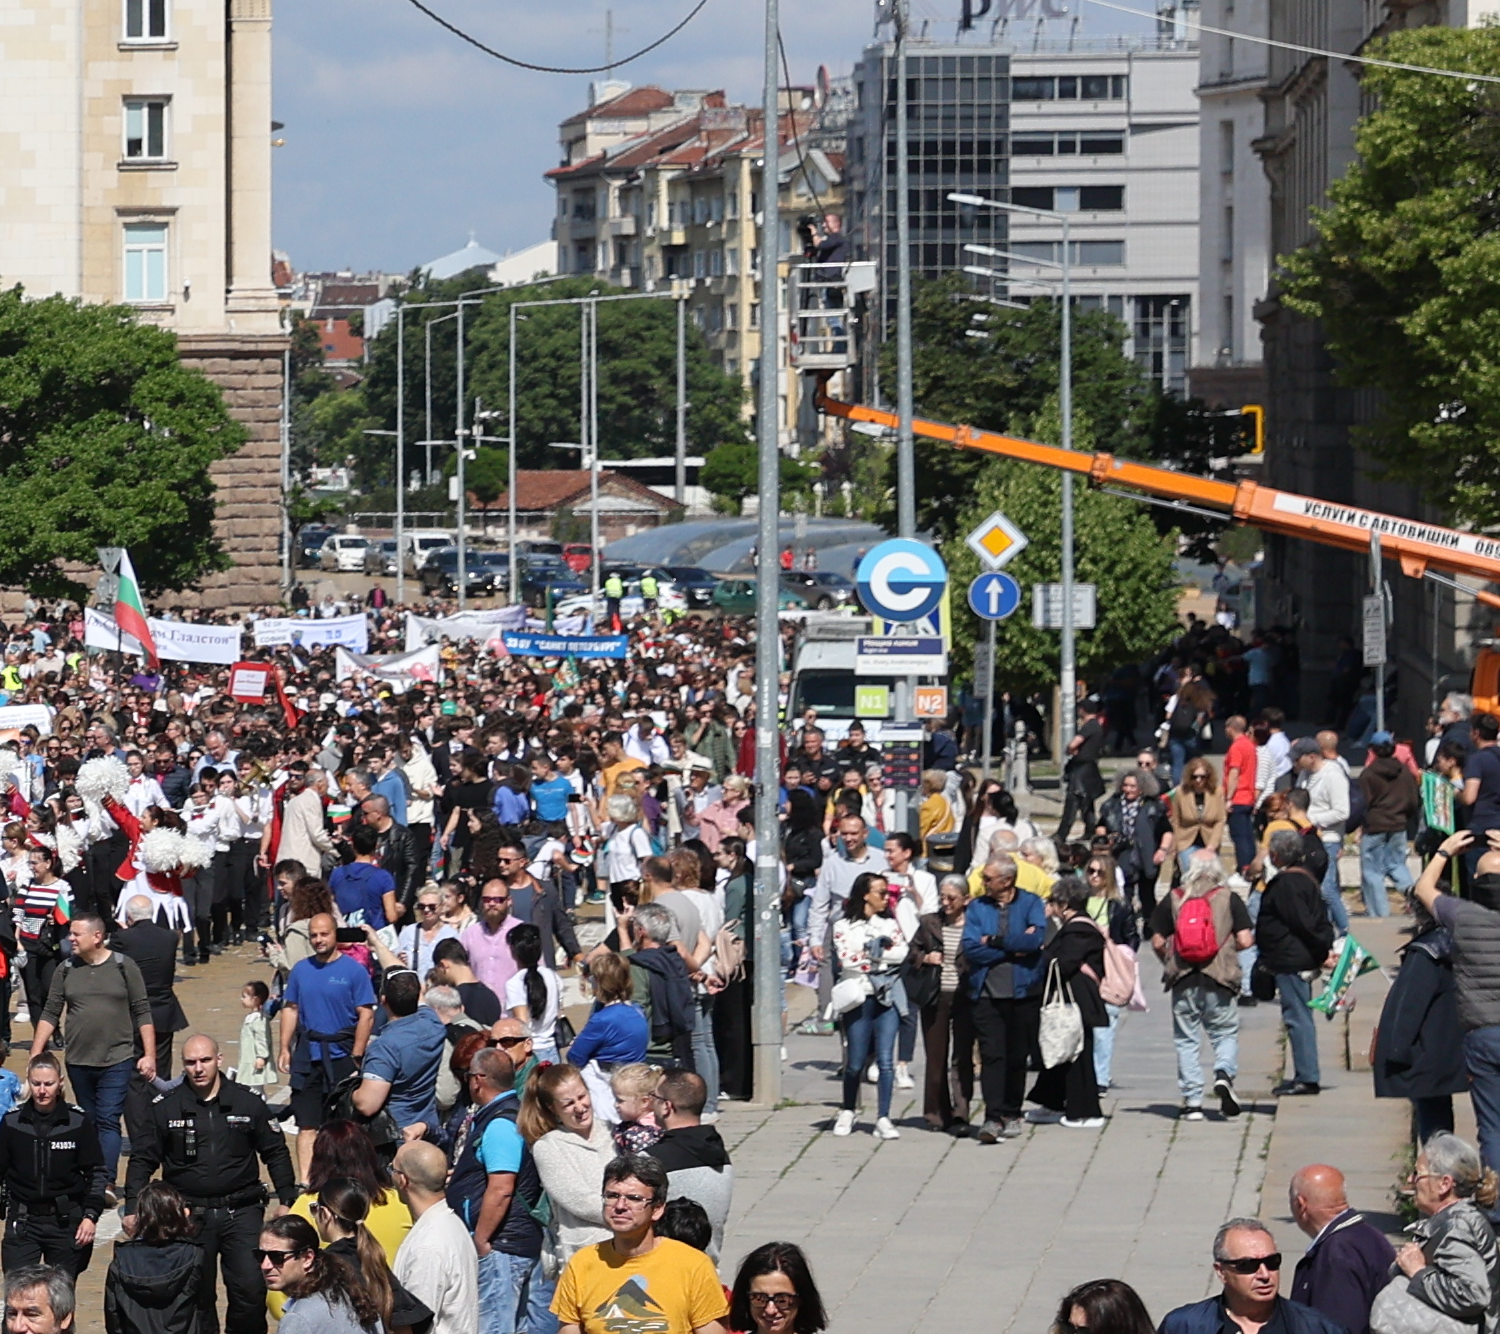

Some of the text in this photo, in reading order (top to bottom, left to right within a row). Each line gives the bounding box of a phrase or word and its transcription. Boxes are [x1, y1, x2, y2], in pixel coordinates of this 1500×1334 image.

[1303, 500, 1357, 525] УСЛУГИ
[1371, 518, 1460, 548] АВТОВИШКИ
[861, 695, 883, 709] N1
[918, 695, 942, 709] N2
